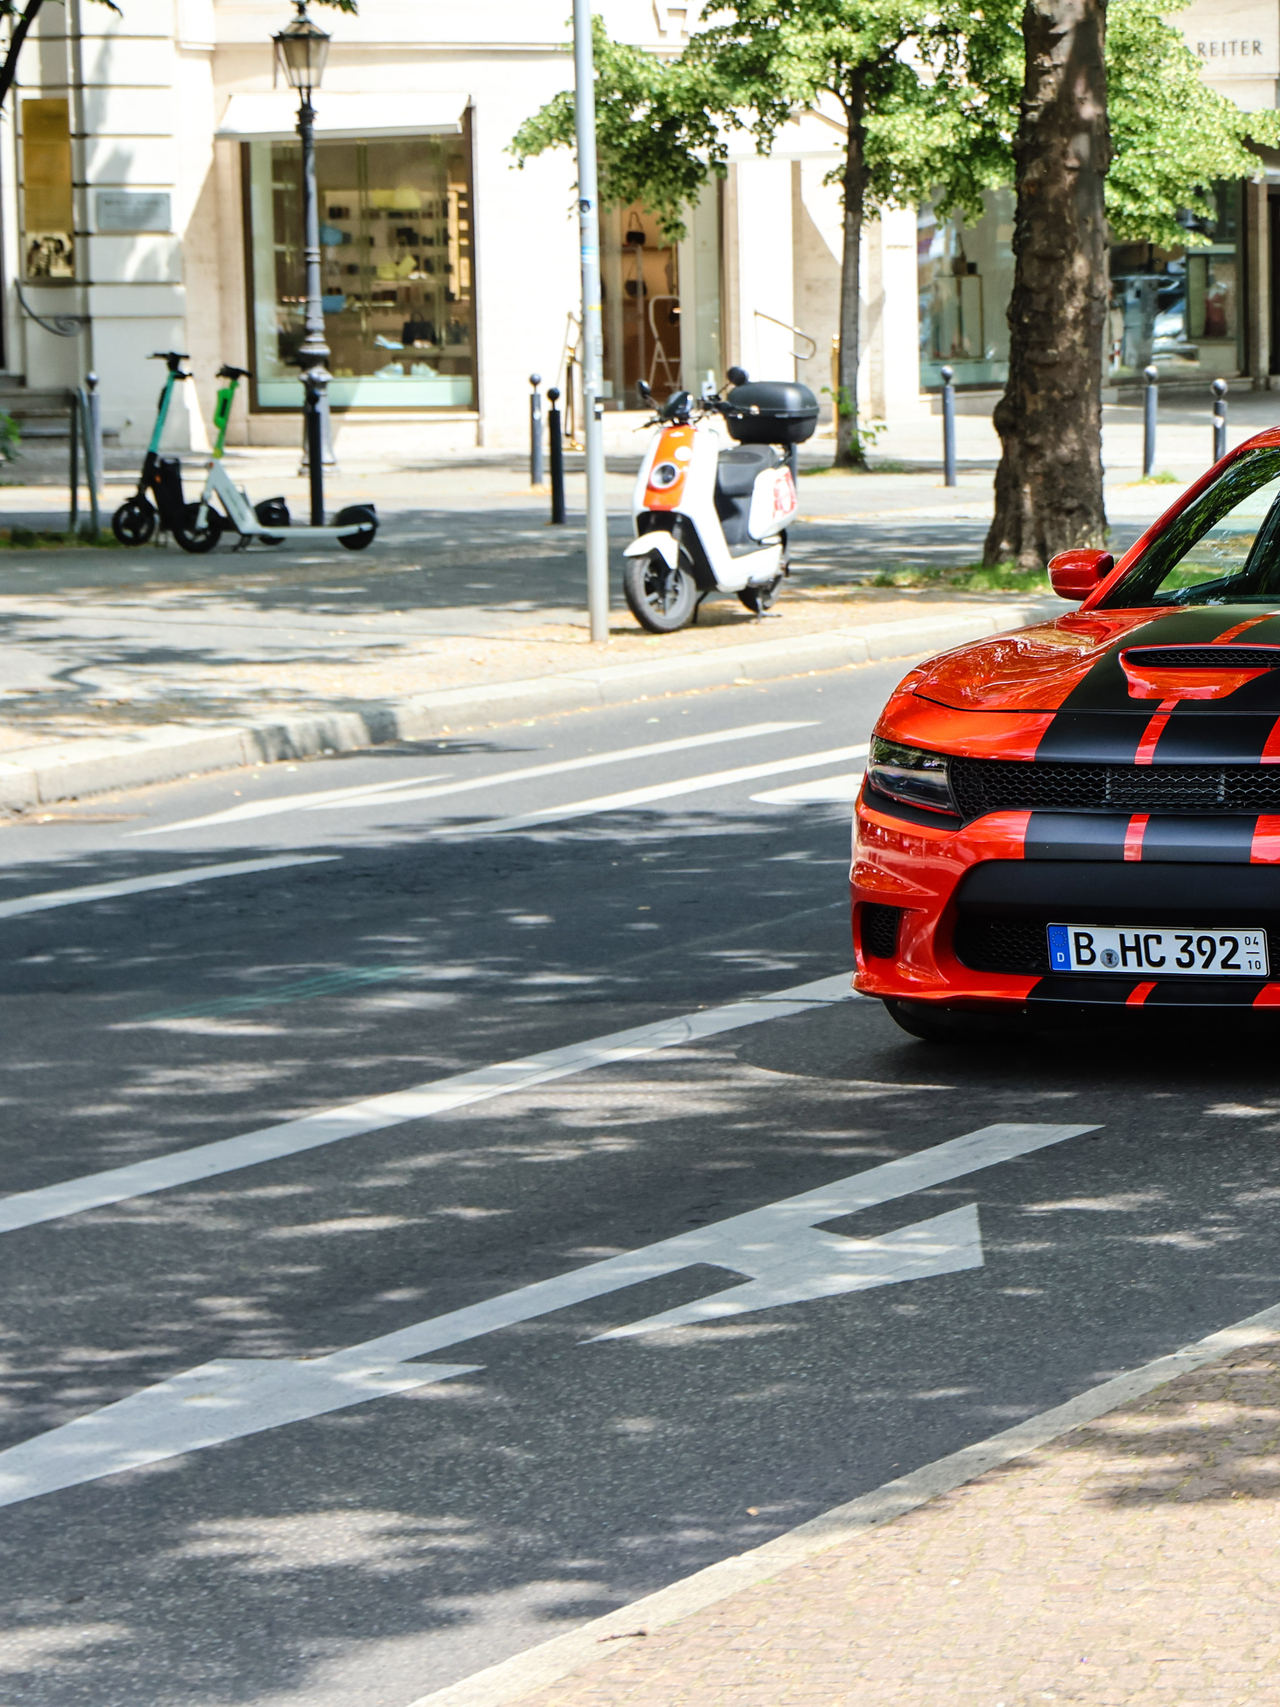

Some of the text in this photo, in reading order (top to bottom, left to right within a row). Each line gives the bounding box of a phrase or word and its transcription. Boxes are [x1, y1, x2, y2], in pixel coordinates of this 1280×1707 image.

[1197, 40, 1263, 57] REITER
[1244, 935, 1259, 946] 04
[1073, 931, 1241, 970] B HC 392
[1057, 952, 1065, 963] D
[1247, 960, 1262, 970] 10
